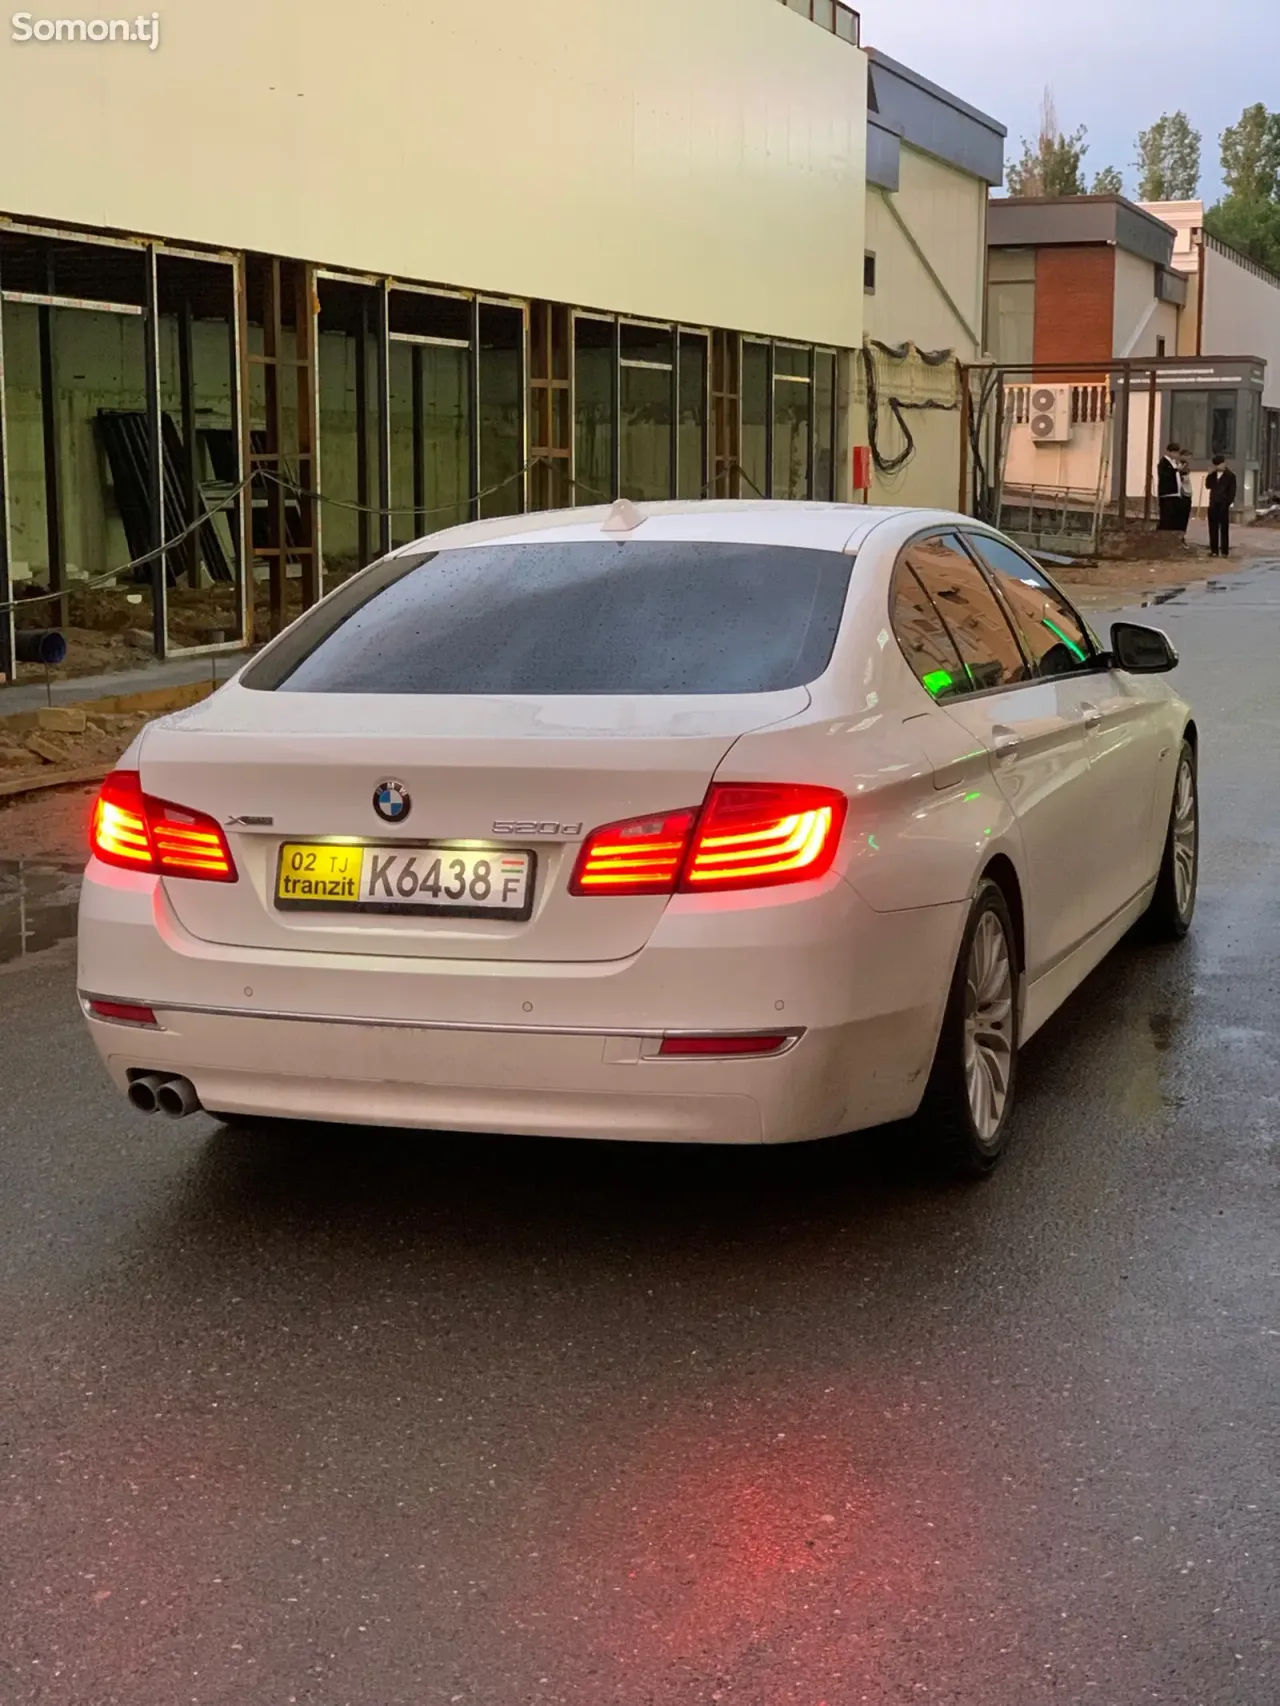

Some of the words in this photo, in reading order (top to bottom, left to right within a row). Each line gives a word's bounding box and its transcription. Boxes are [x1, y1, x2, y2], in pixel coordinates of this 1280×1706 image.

[492, 820, 583, 835] 520d
[291, 852, 317, 871] 02
[329, 856, 348, 873] TJ
[284, 875, 355, 896] tranzit
[368, 854, 491, 901] K6438
[502, 878, 520, 902] F
